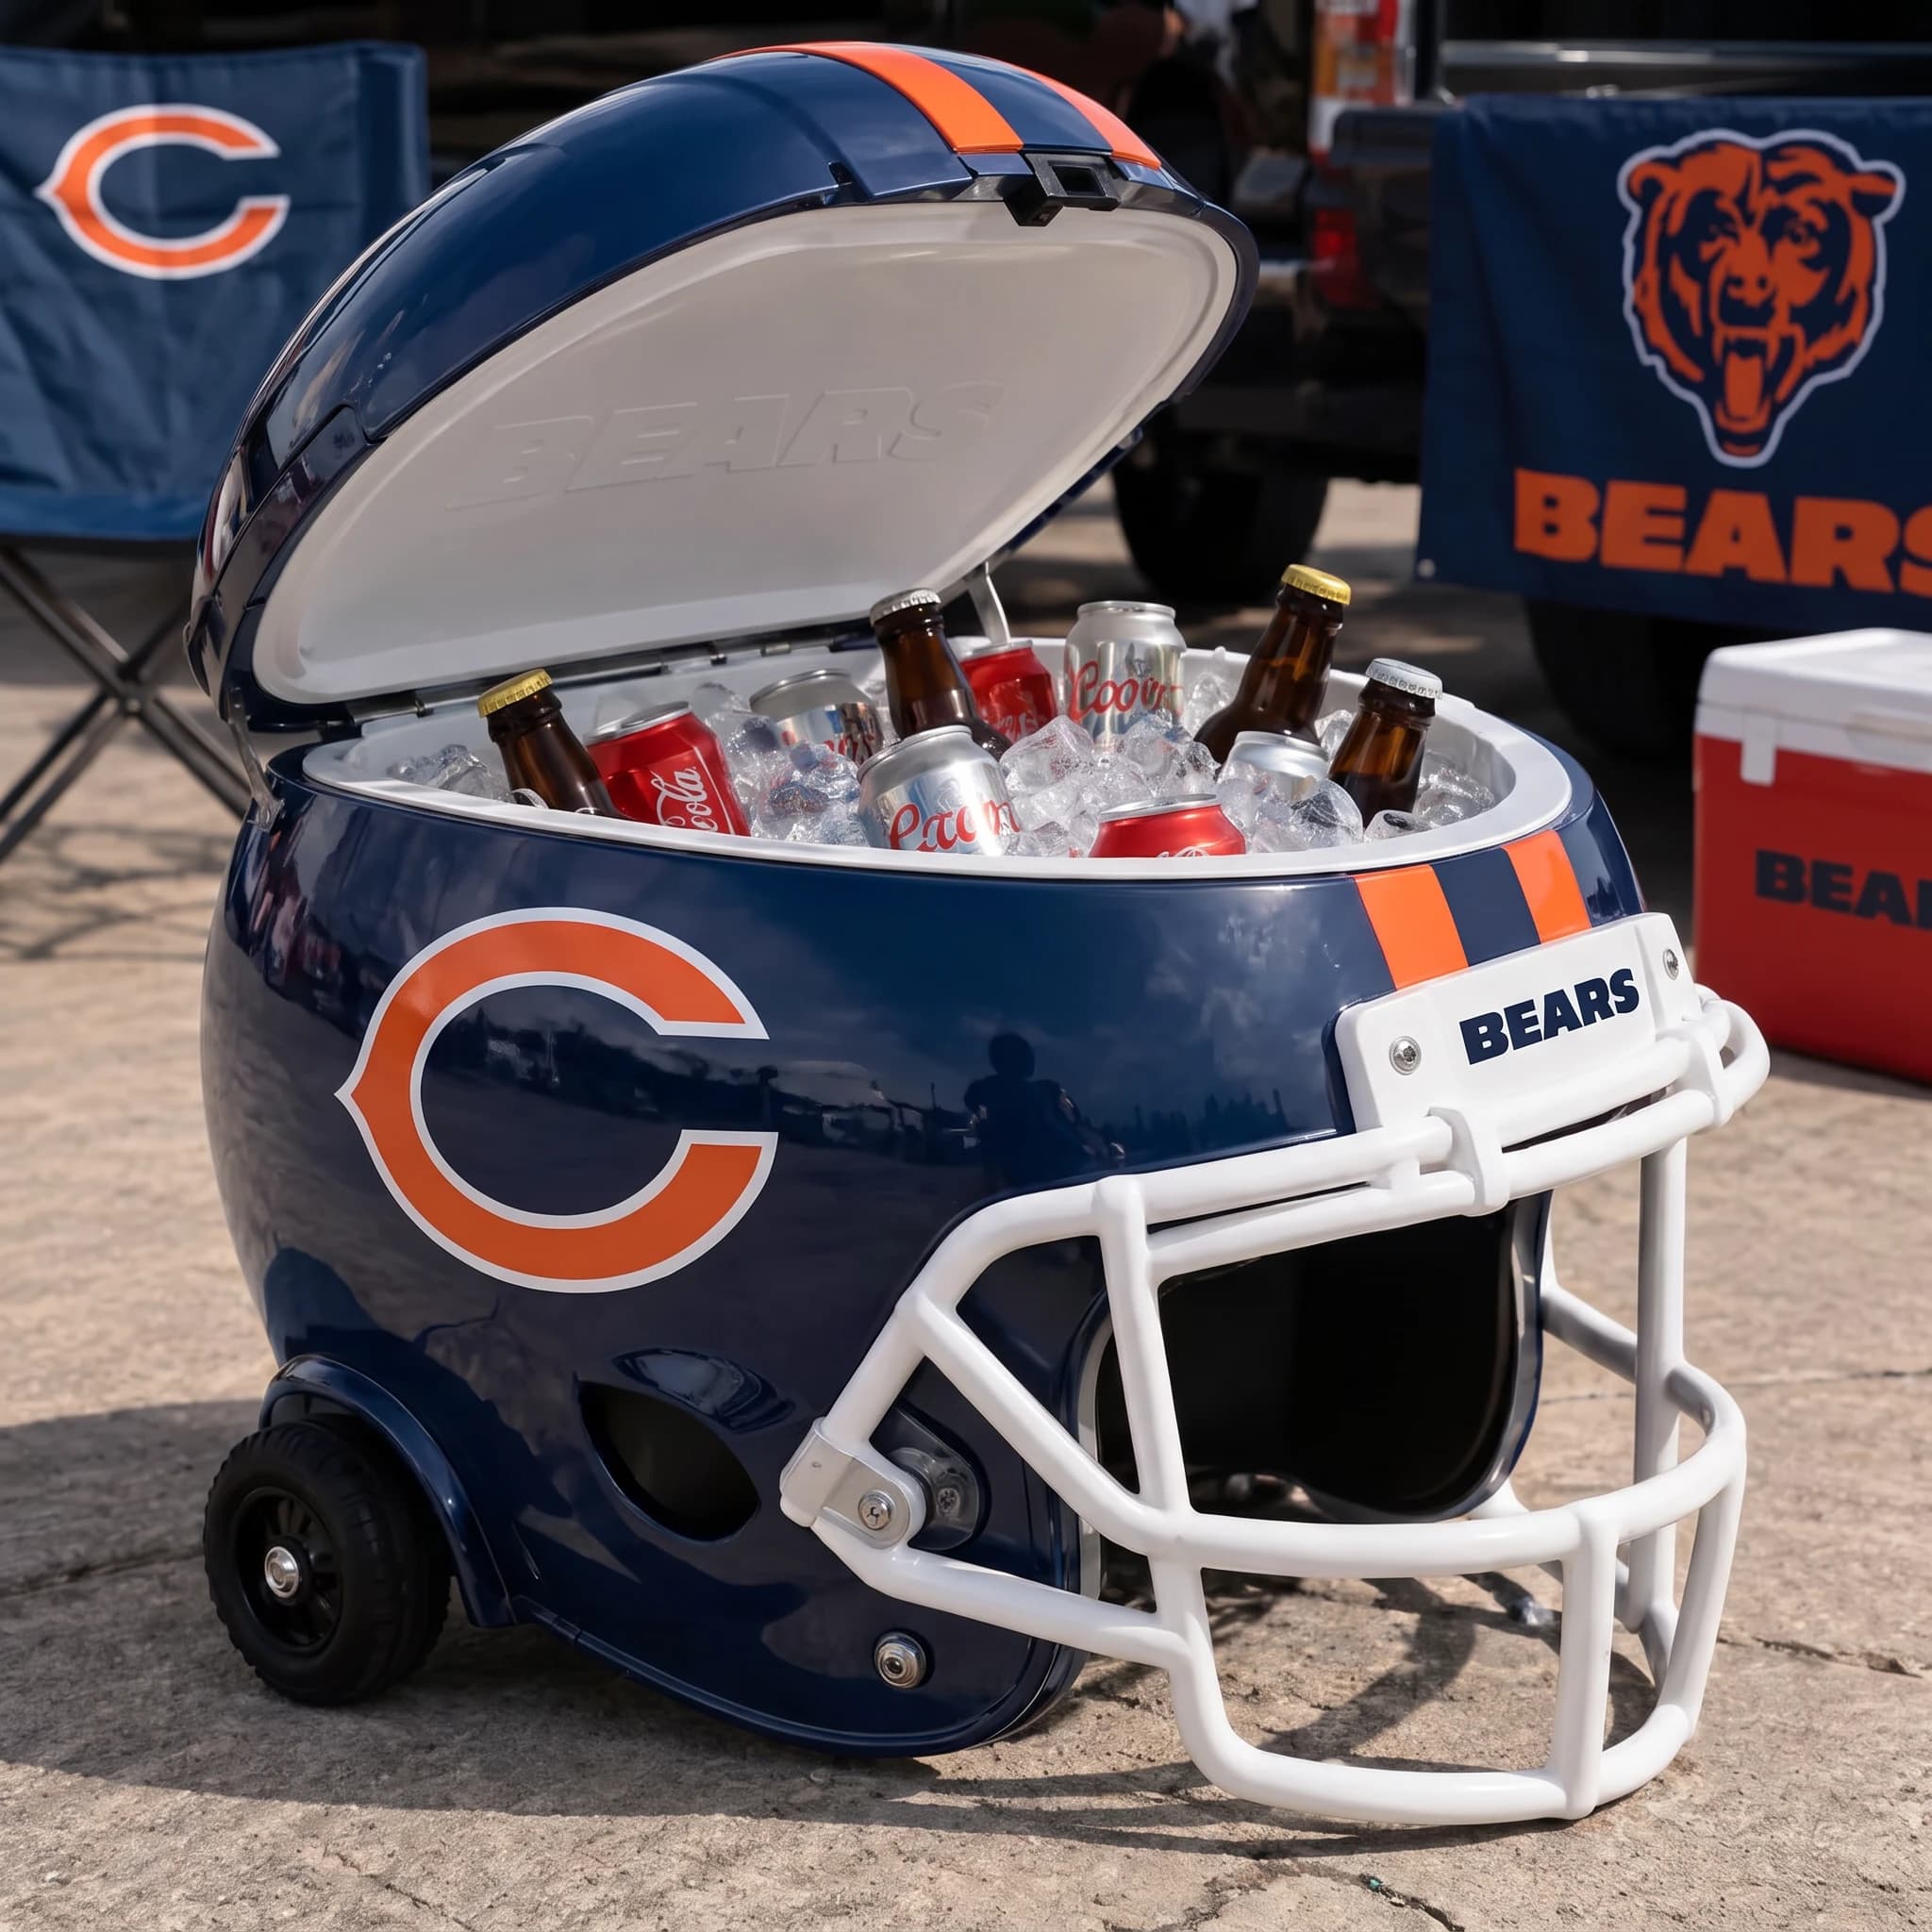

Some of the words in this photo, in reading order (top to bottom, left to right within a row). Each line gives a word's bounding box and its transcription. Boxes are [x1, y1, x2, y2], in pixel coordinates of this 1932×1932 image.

[36, 104, 290, 279] C
[445, 382, 1006, 510] BEARS
[1459, 968, 1640, 1064] BEARS
[335, 908, 779, 1293] C
